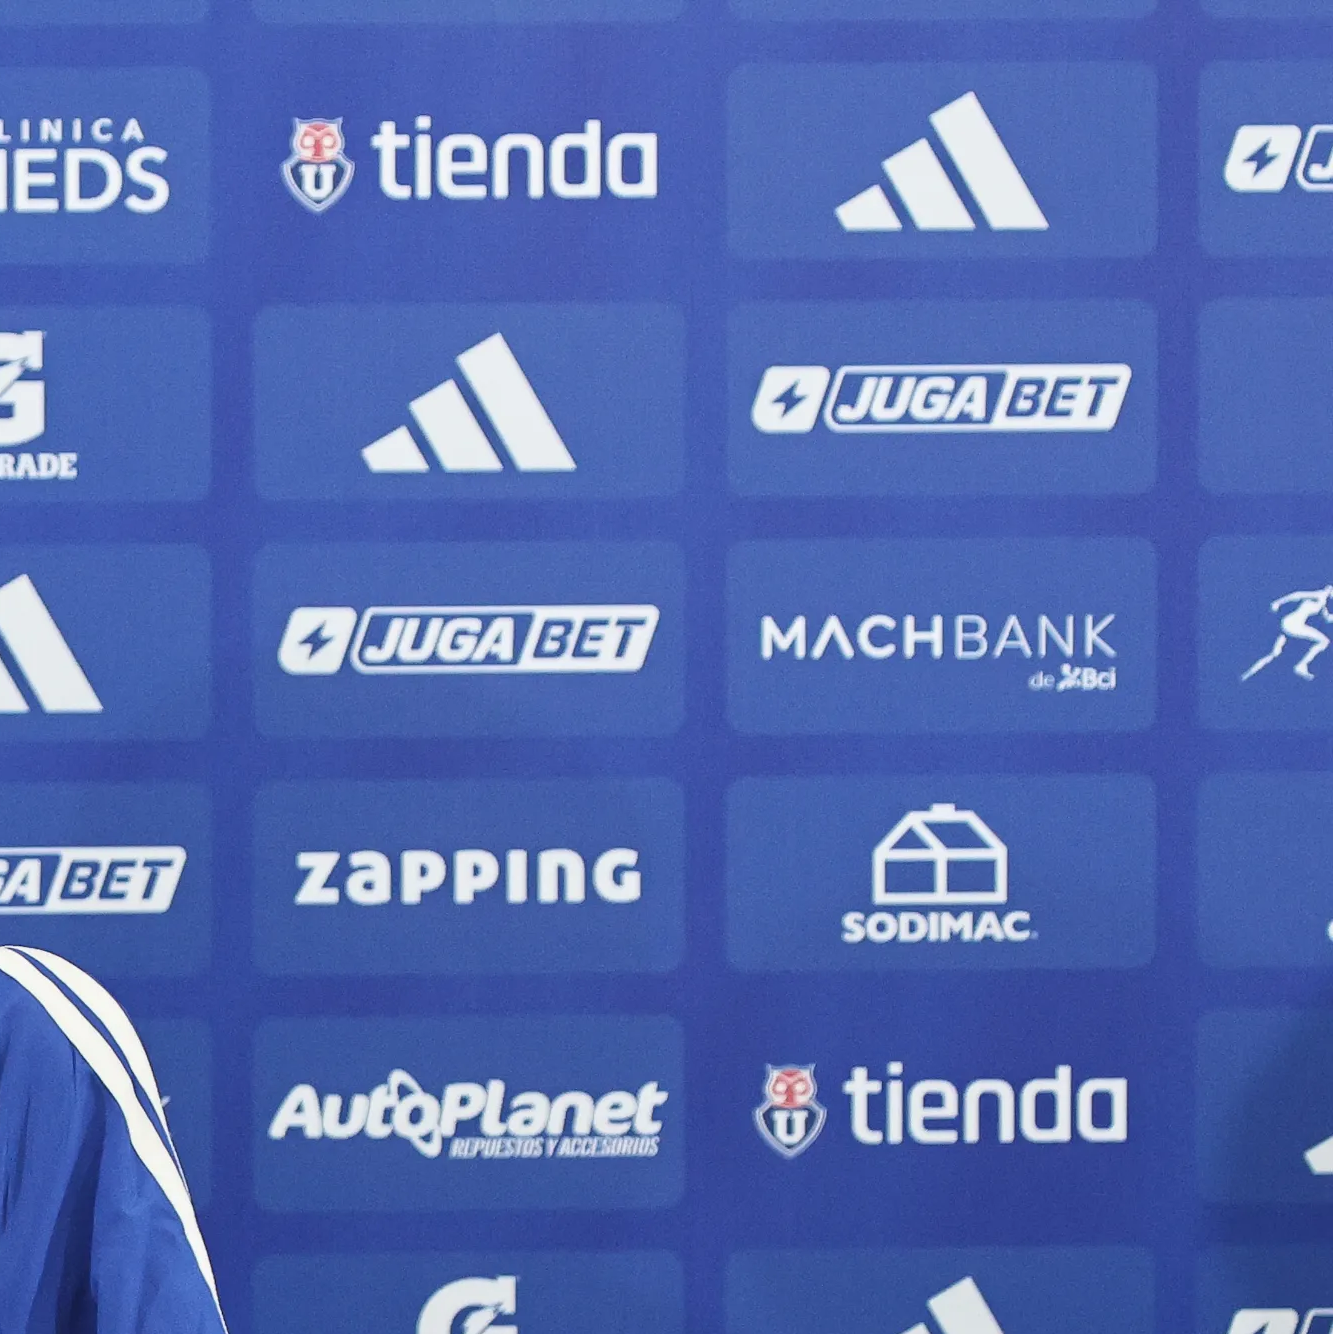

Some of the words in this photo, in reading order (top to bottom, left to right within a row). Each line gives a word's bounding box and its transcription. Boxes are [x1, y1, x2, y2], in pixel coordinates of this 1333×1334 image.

[372, 116, 657, 198] tienda
[299, 163, 337, 199] U
[762, 615, 1115, 659] MACHBANK
[843, 911, 1030, 942] SODIMAC
[269, 1070, 668, 1157] AutoPlanet
[844, 1062, 1127, 1144] tienda
[771, 1109, 810, 1150] U
